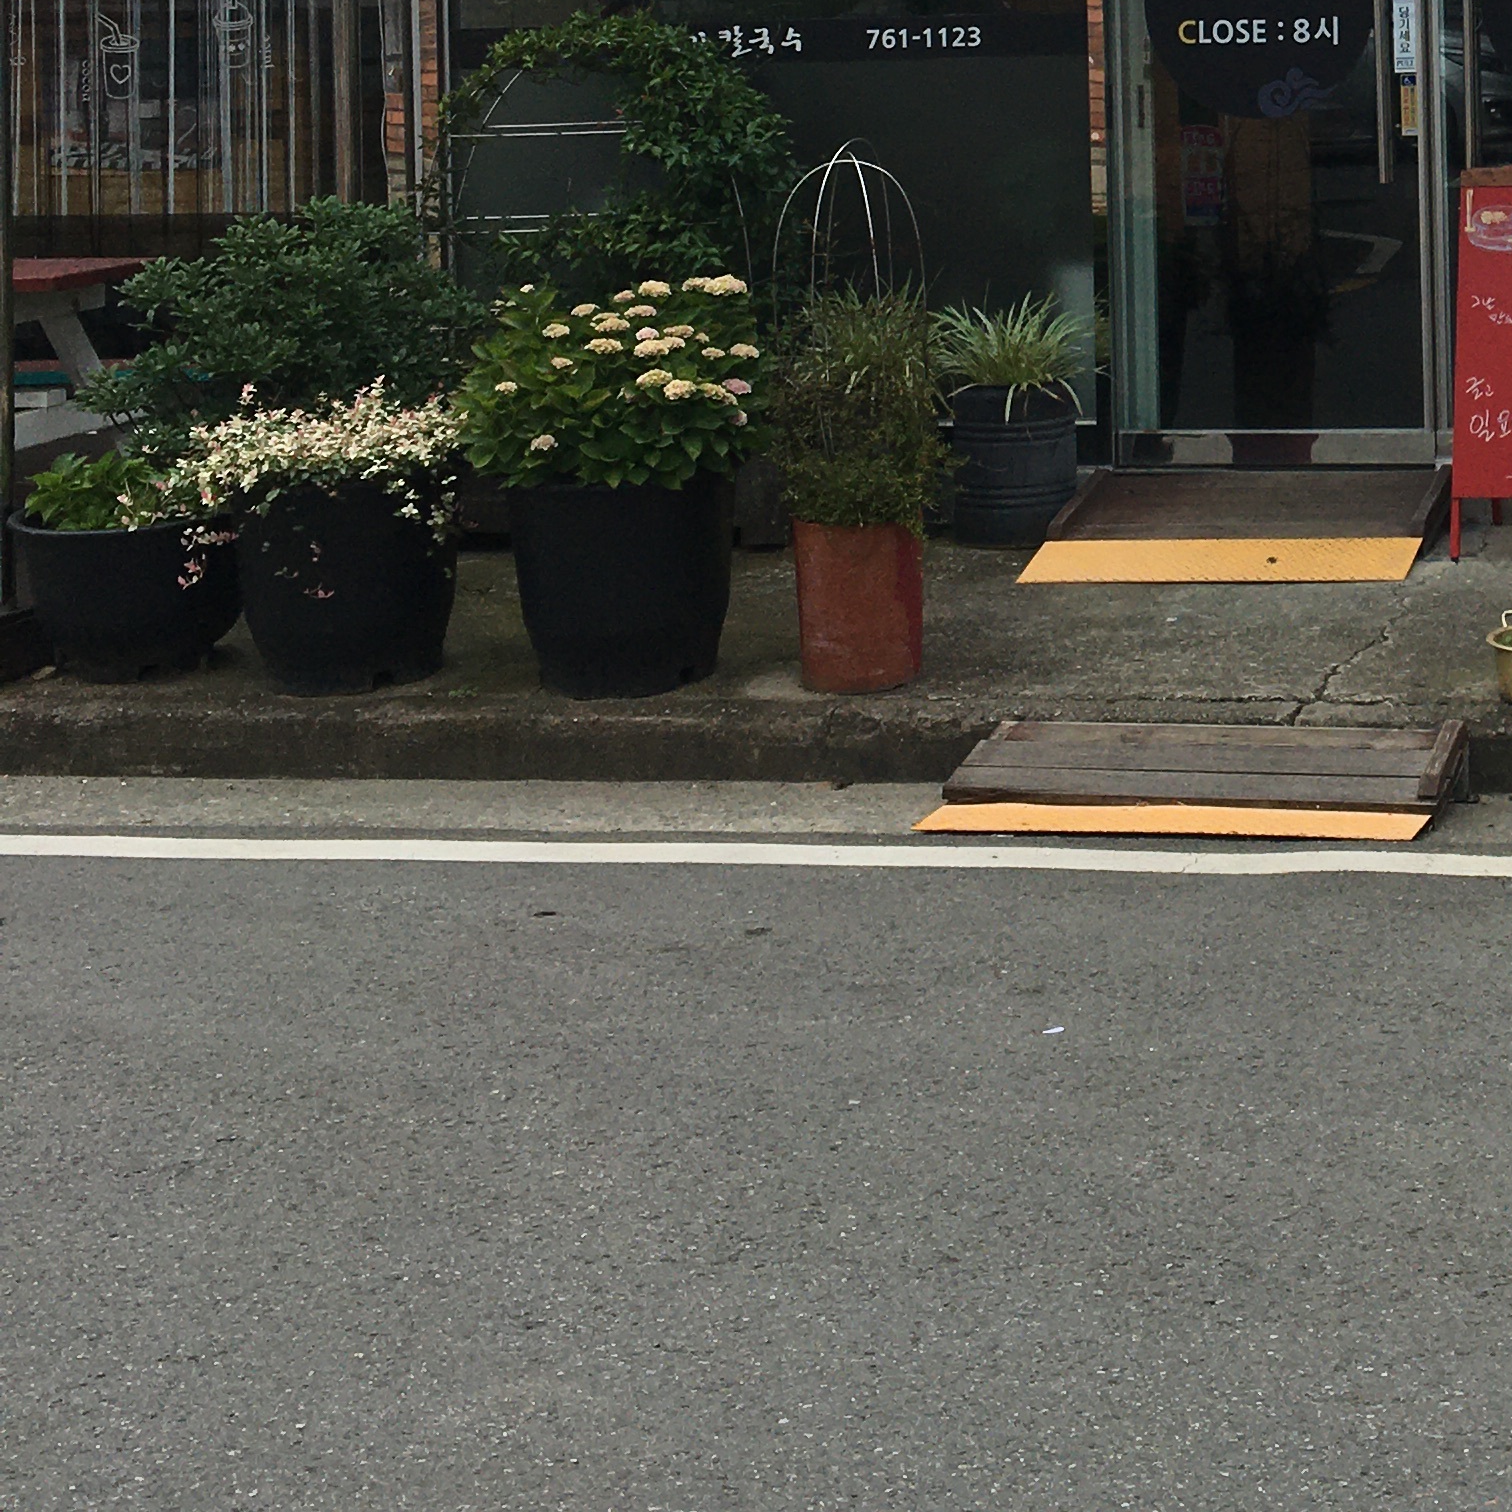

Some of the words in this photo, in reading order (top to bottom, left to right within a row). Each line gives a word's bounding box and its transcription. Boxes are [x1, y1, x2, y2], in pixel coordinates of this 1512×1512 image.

[718, 25, 802, 58] 칼국수
[866, 26, 982, 50] 761-1123
[1178, 19, 1267, 45] CLOSE
[1292, 16, 1341, 46] 8시
[1398, 6, 1411, 53] 당기세요
